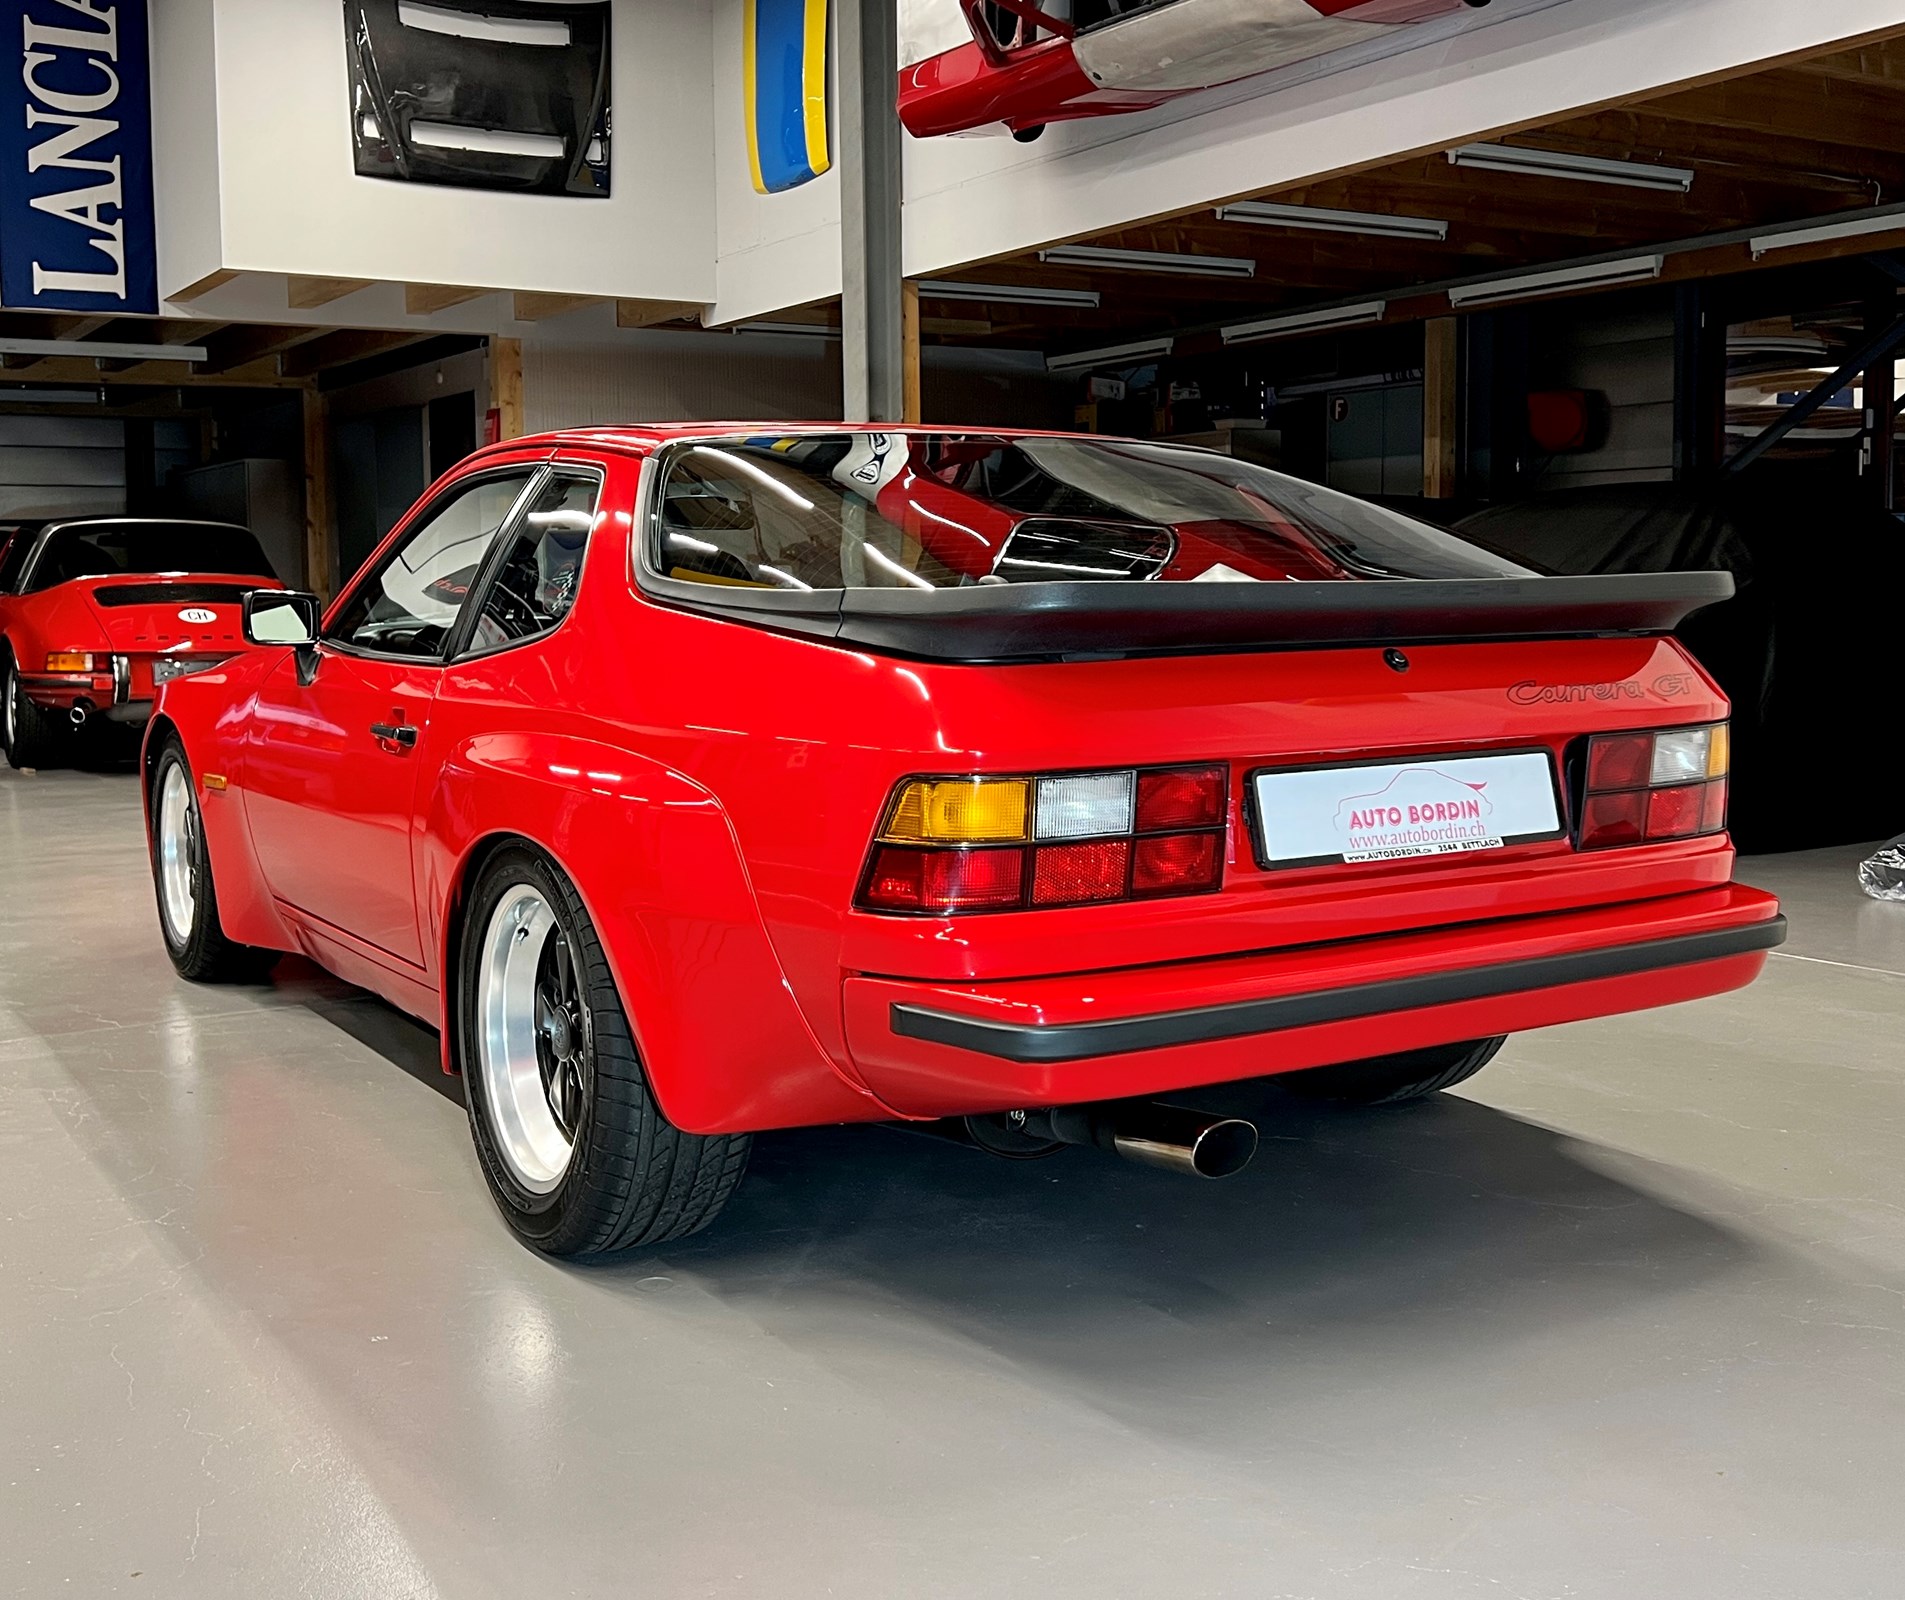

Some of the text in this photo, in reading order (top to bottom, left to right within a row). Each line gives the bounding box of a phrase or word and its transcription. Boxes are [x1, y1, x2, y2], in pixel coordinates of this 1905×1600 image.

[1335, 399, 1345, 420] F
[187, 611, 209, 621] CH
[1507, 673, 1692, 706] Carrera GT
[1349, 800, 1481, 830] AUTO BORDIN
[1349, 820, 1486, 850] www.autobordin.ch
[1462, 838, 1500, 850] BETTLACH
